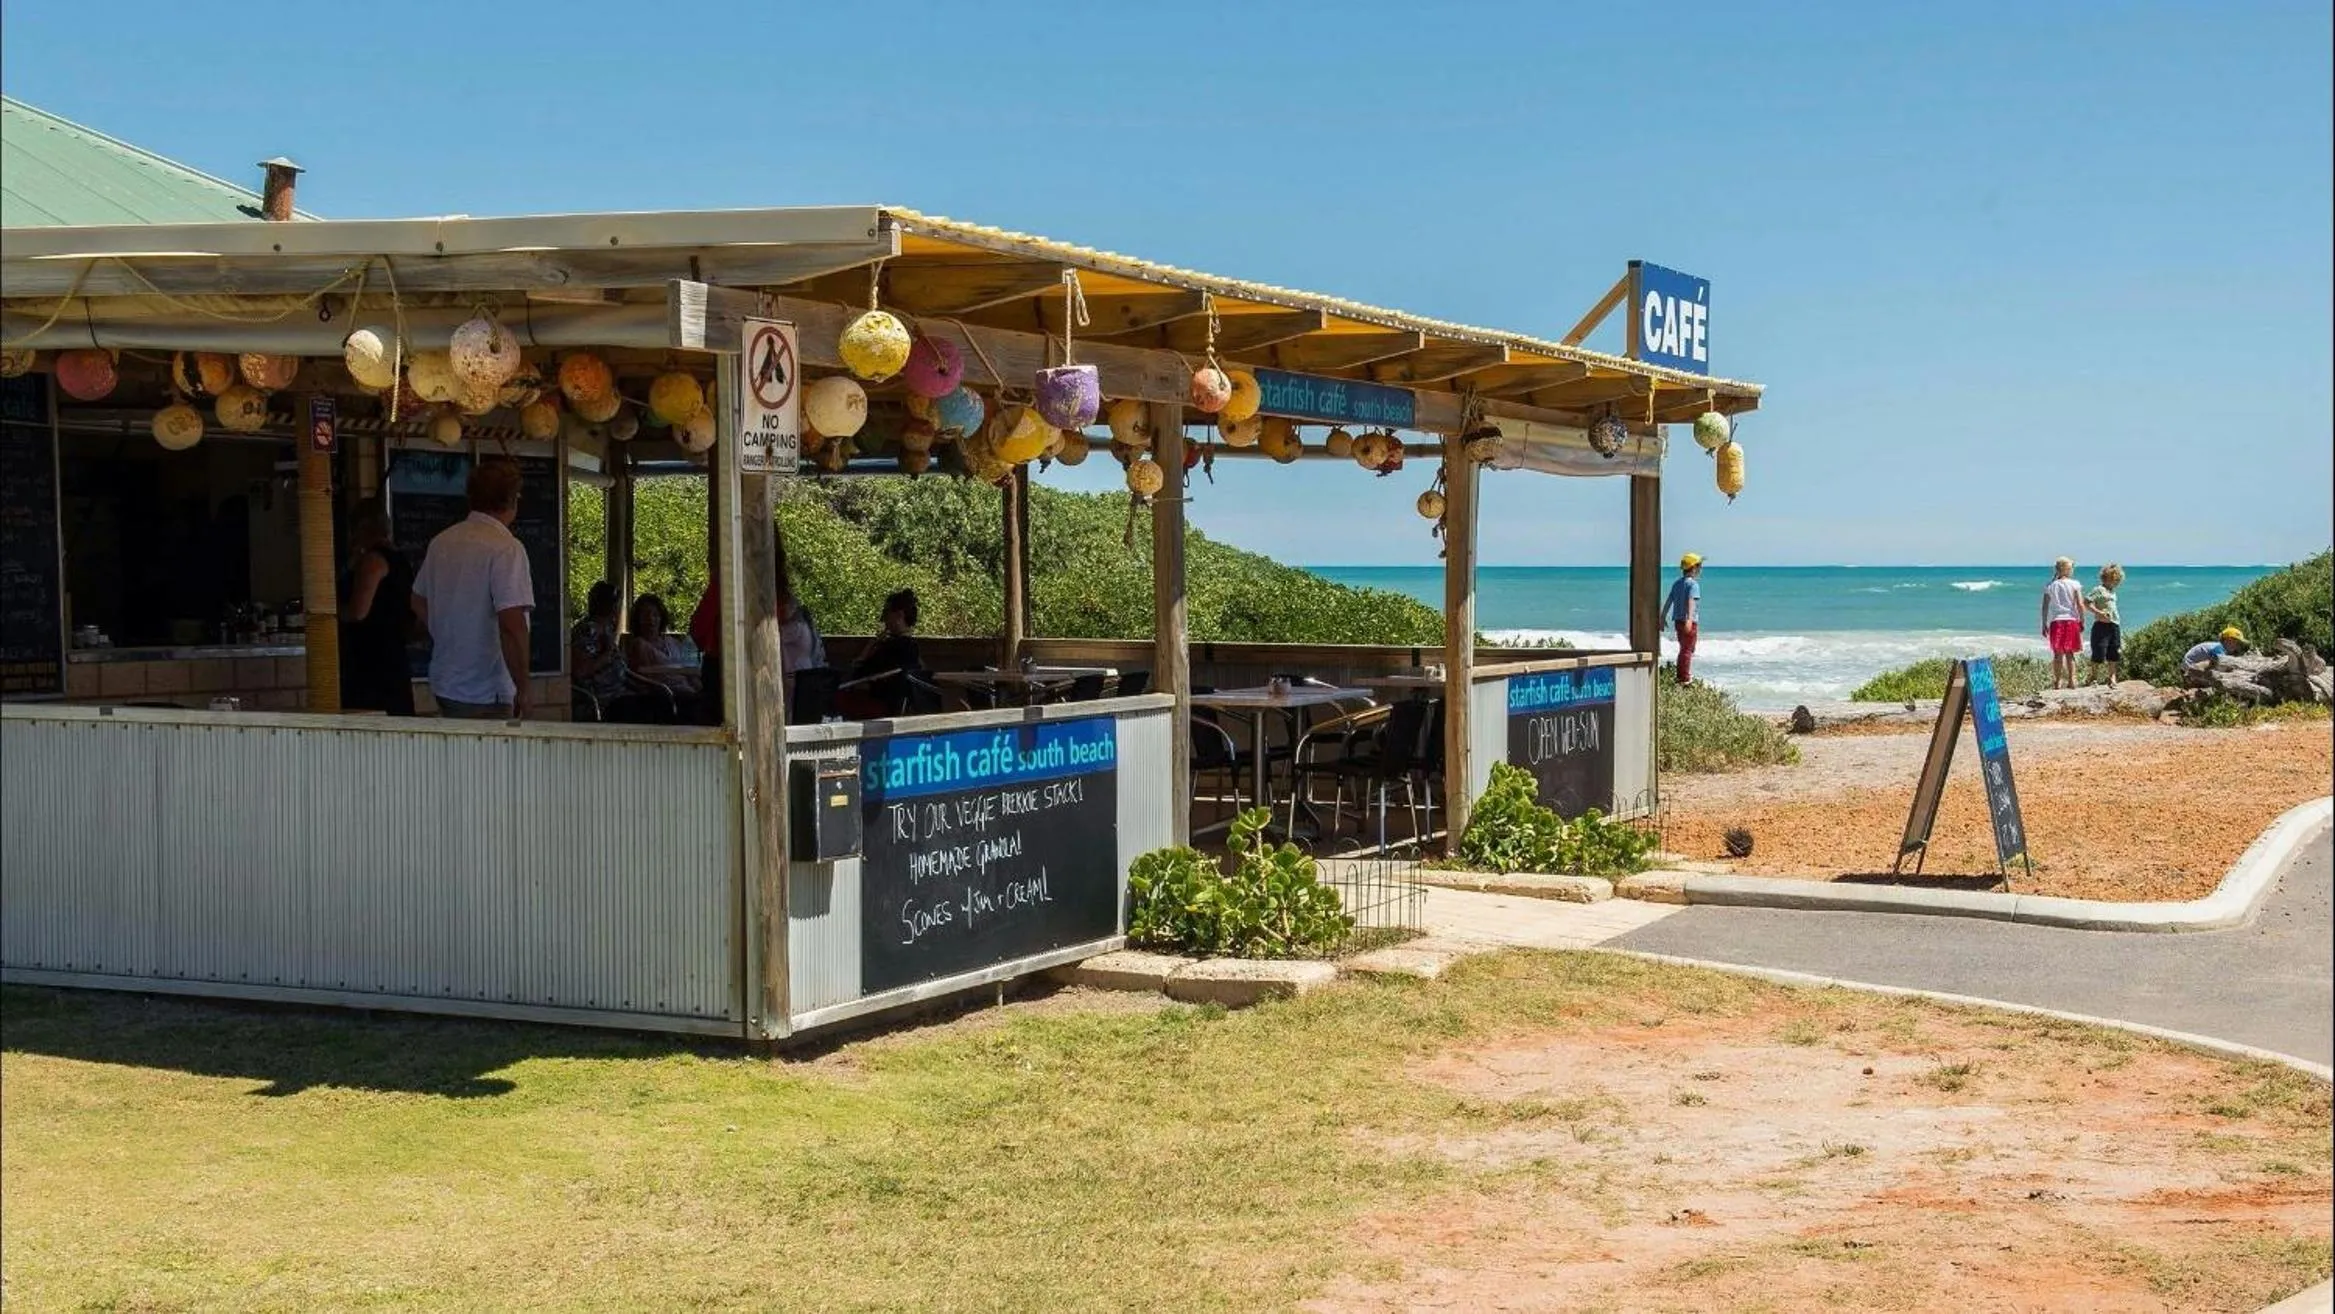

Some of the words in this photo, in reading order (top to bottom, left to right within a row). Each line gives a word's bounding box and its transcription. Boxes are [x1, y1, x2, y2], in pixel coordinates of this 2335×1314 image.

[1644, 286, 1707, 362] CAFÉ
[762, 413, 780, 430] NO
[1319, 384, 1348, 415] café
[1352, 396, 1382, 419] south
[1383, 398, 1412, 422] beach
[743, 431, 797, 450] CAMPING
[1509, 677, 1548, 708] starfish
[1550, 675, 1570, 702] café
[1593, 677, 1616, 697] beach
[866, 741, 960, 791] starfish
[967, 734, 1013, 778] café
[1018, 737, 1065, 772] south
[1070, 731, 1114, 765] beach
[1528, 717, 1558, 765] OPEN
[887, 803, 917, 844] TRY
[925, 802, 952, 839] OUR
[955, 794, 999, 832] VEGGIE
[1044, 778, 1084, 809] STACK!
[909, 846, 972, 885] HOMEMADE
[902, 898, 953, 944] SCONES
